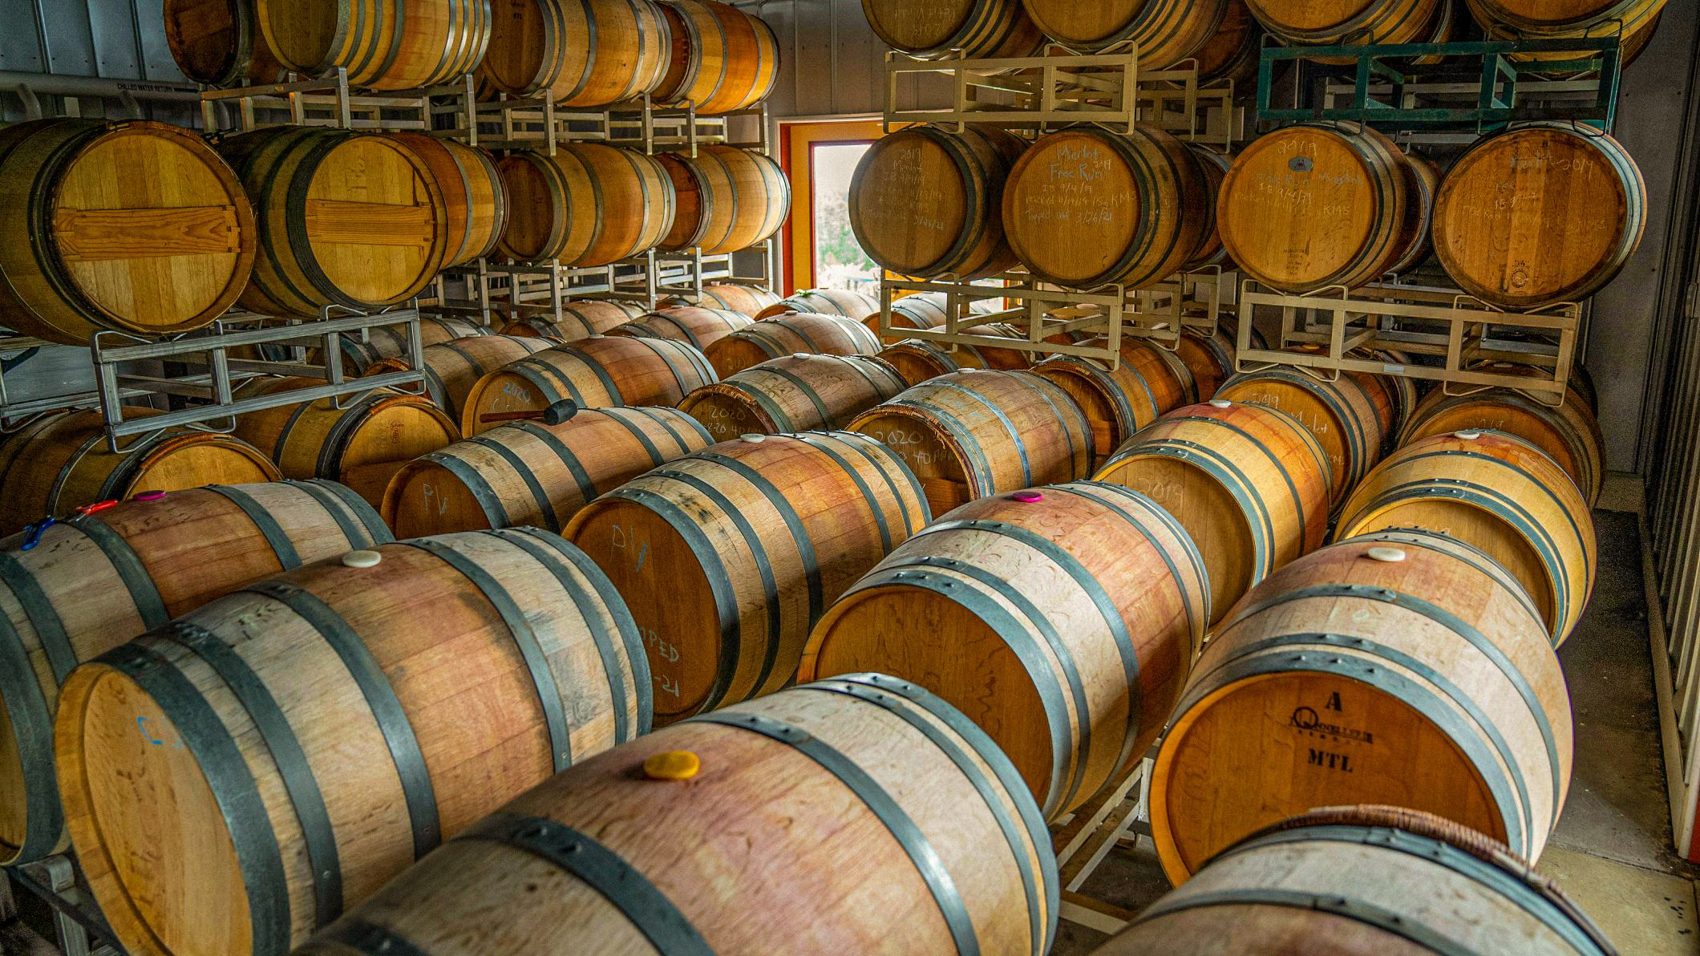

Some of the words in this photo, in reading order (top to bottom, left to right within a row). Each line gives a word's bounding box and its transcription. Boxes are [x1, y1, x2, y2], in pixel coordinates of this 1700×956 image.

[138, 84, 154, 92] WATER
[1057, 144, 1100, 161] Merlot
[1049, 164, 1075, 183] Free
[1079, 161, 1102, 182] Run
[710, 405, 746, 421] 2020
[875, 430, 923, 446] 2020
[422, 483, 450, 517] PV
[1325, 690, 1343, 712] A
[1307, 747, 1355, 774] MTL
